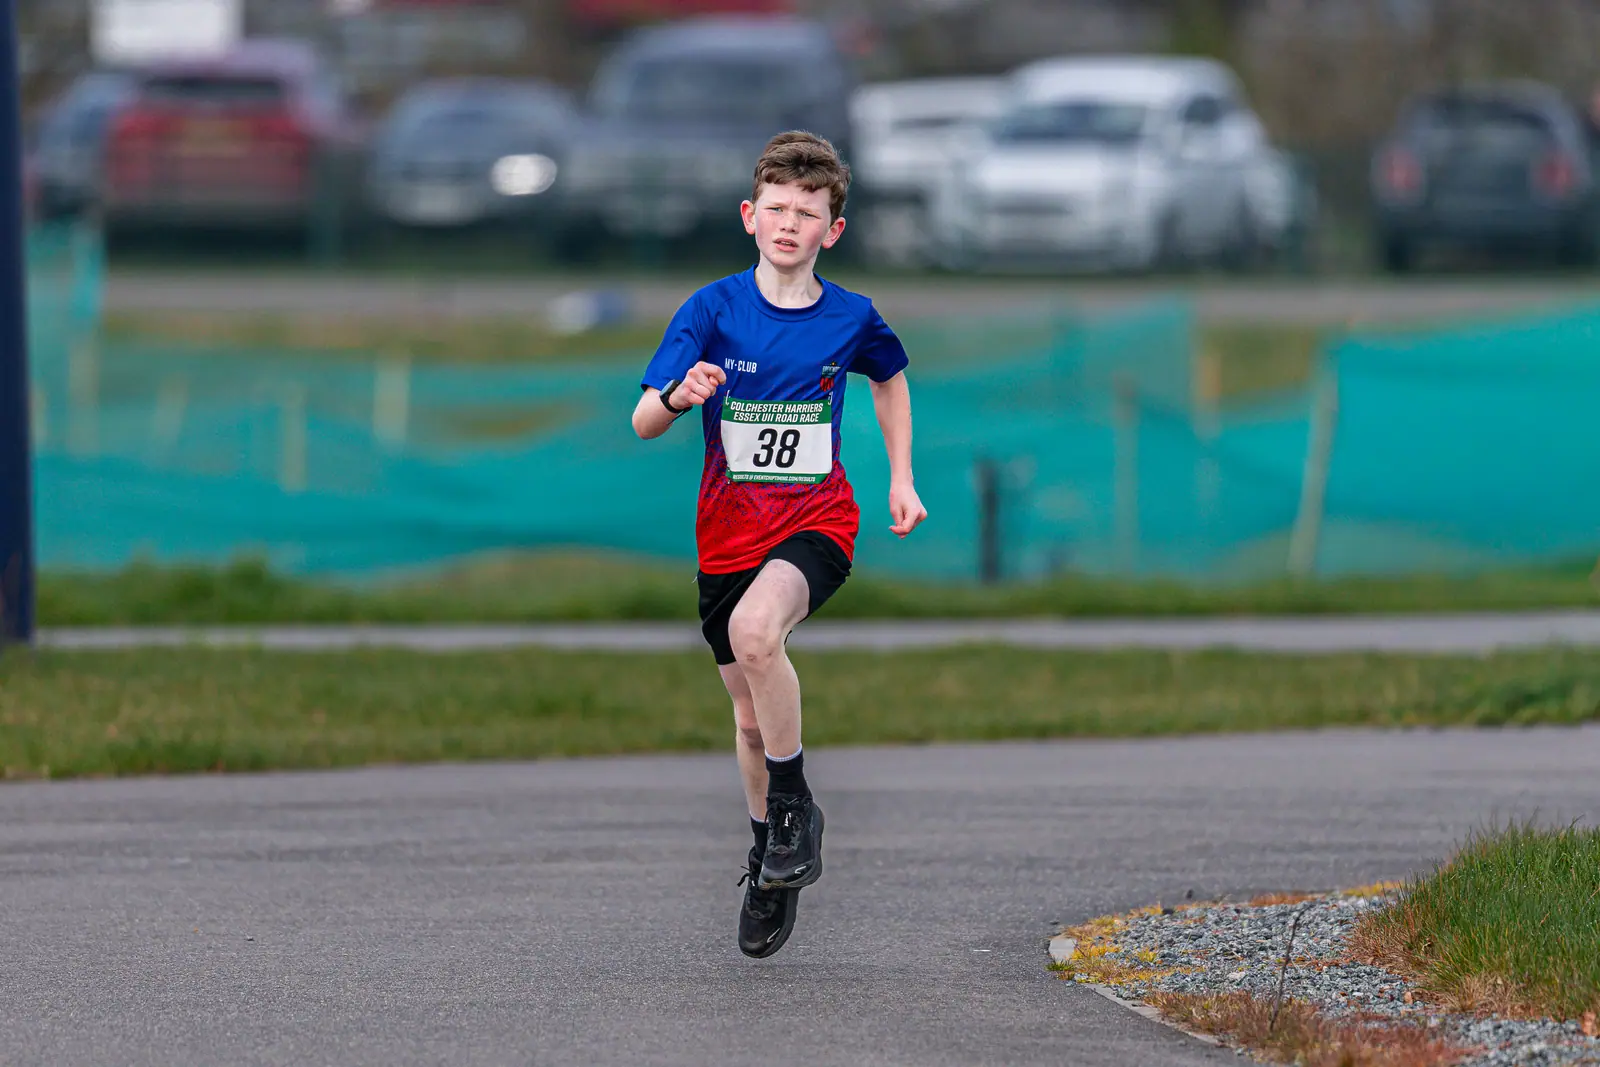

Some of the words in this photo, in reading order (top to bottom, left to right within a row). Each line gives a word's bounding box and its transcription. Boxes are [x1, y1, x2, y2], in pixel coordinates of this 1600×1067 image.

[730, 401, 784, 412] COLCHESTER
[785, 402, 824, 413] HARRIERS
[733, 411, 761, 421] ESSEX
[775, 413, 799, 423] ROAD
[799, 412, 820, 423] RACE
[752, 428, 801, 468] 38
